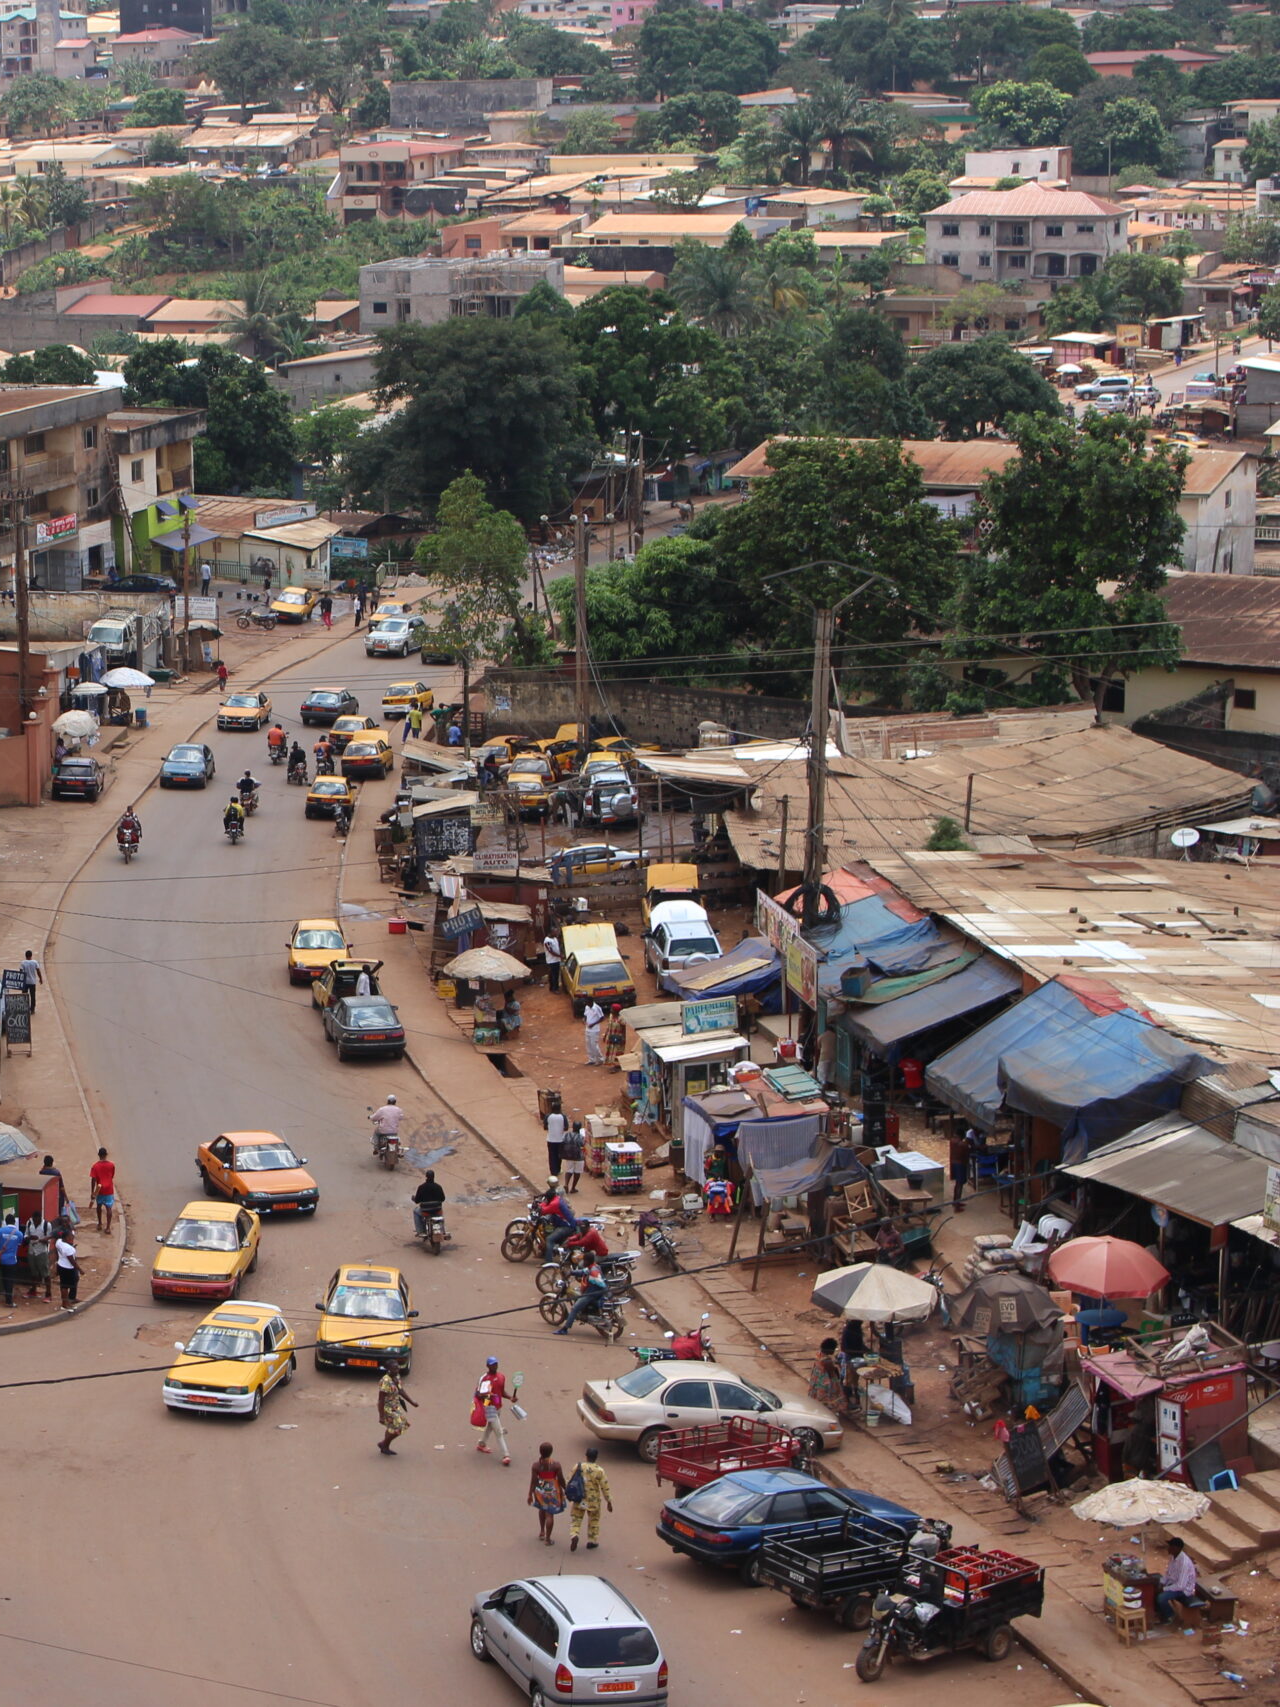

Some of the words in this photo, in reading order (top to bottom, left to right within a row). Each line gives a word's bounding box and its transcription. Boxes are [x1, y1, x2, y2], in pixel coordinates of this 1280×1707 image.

[474, 852, 517, 860] CLIMATISATION
[441, 909, 481, 933] PHOTO
[5, 971, 25, 981] PHOTO
